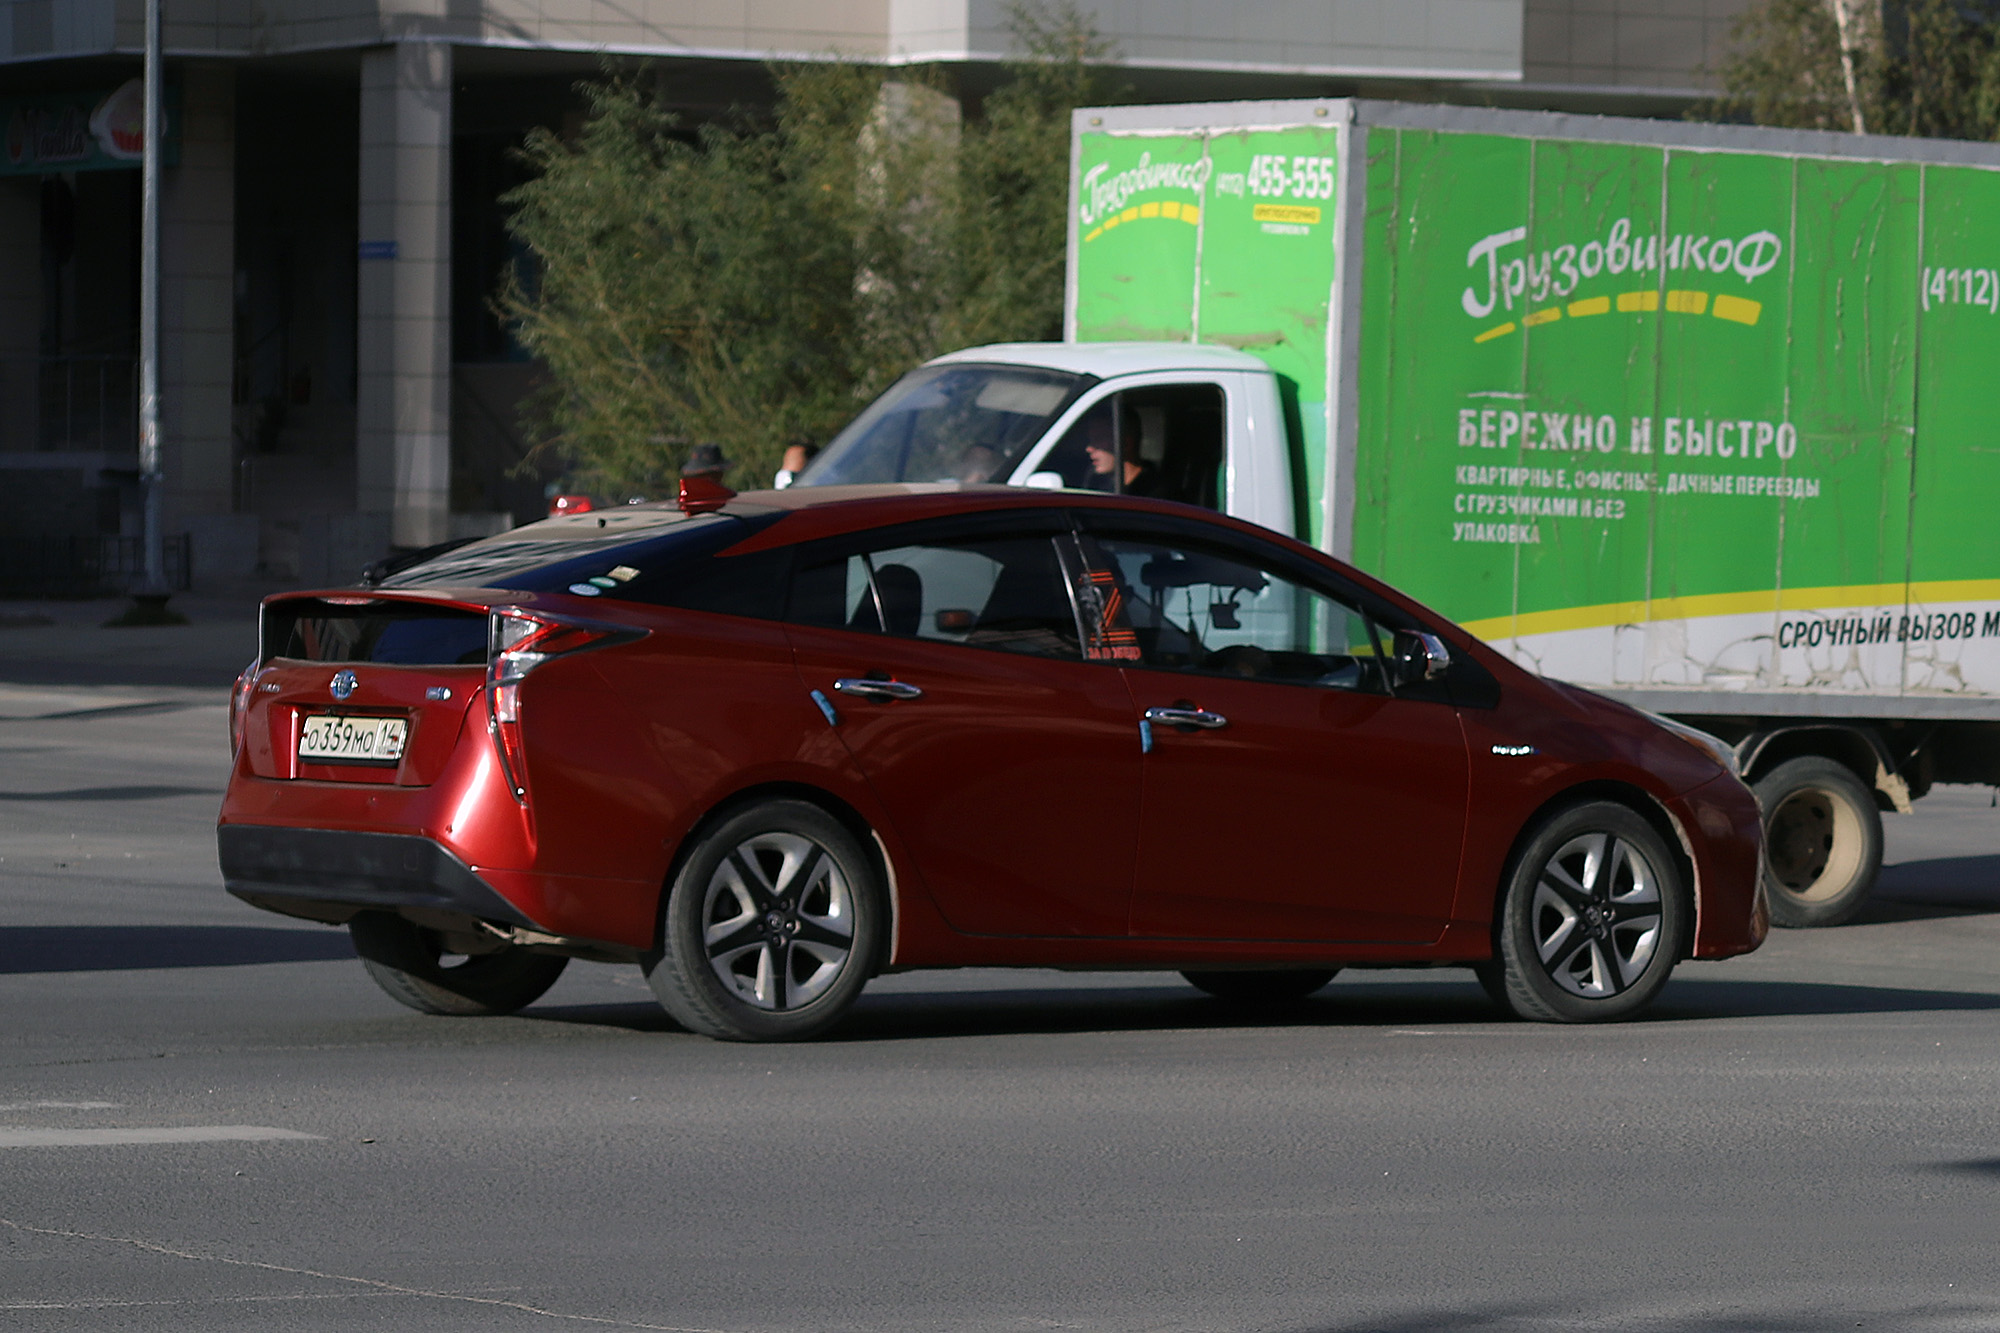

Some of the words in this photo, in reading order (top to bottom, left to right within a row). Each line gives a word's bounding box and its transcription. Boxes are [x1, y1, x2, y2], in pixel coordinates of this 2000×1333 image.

[1247, 154, 1334, 199] 455-555
[1922, 266, 1999, 314] (4112)
[1458, 409, 1617, 453] БЕРЕЖНО
[1630, 416, 1652, 454] И
[1663, 417, 1797, 459] БЫСТРО
[1666, 473, 1734, 495] ДАЧНЫЕ
[1736, 475, 1820, 499] ПЕРЕЕЗДЫ
[1454, 494, 1465, 513] С
[1467, 495, 1578, 517] ГРУЗЧИКАМИ
[1581, 499, 1592, 517] И
[1594, 499, 1626, 519] БЕЗ
[1453, 522, 1541, 544] УПАКОВКА
[1779, 611, 1892, 649] СРОЧНЫЙ
[1897, 612, 1976, 643] ВЫЗОВ
